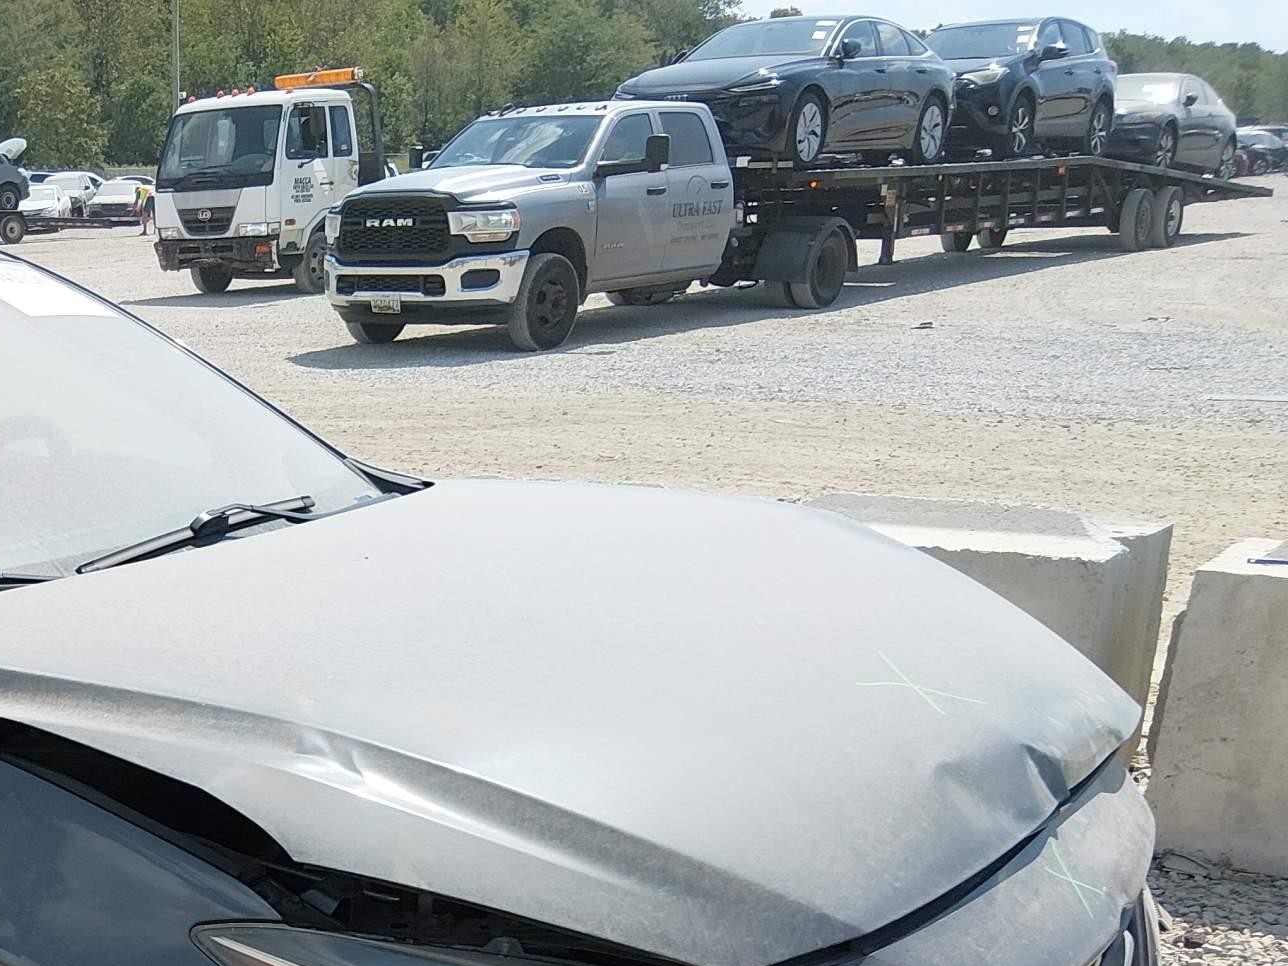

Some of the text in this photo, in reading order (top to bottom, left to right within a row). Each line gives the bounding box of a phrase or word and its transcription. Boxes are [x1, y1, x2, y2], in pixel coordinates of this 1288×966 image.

[673, 200, 722, 217] ULTRA FAST
[365, 218, 413, 227] RAM
